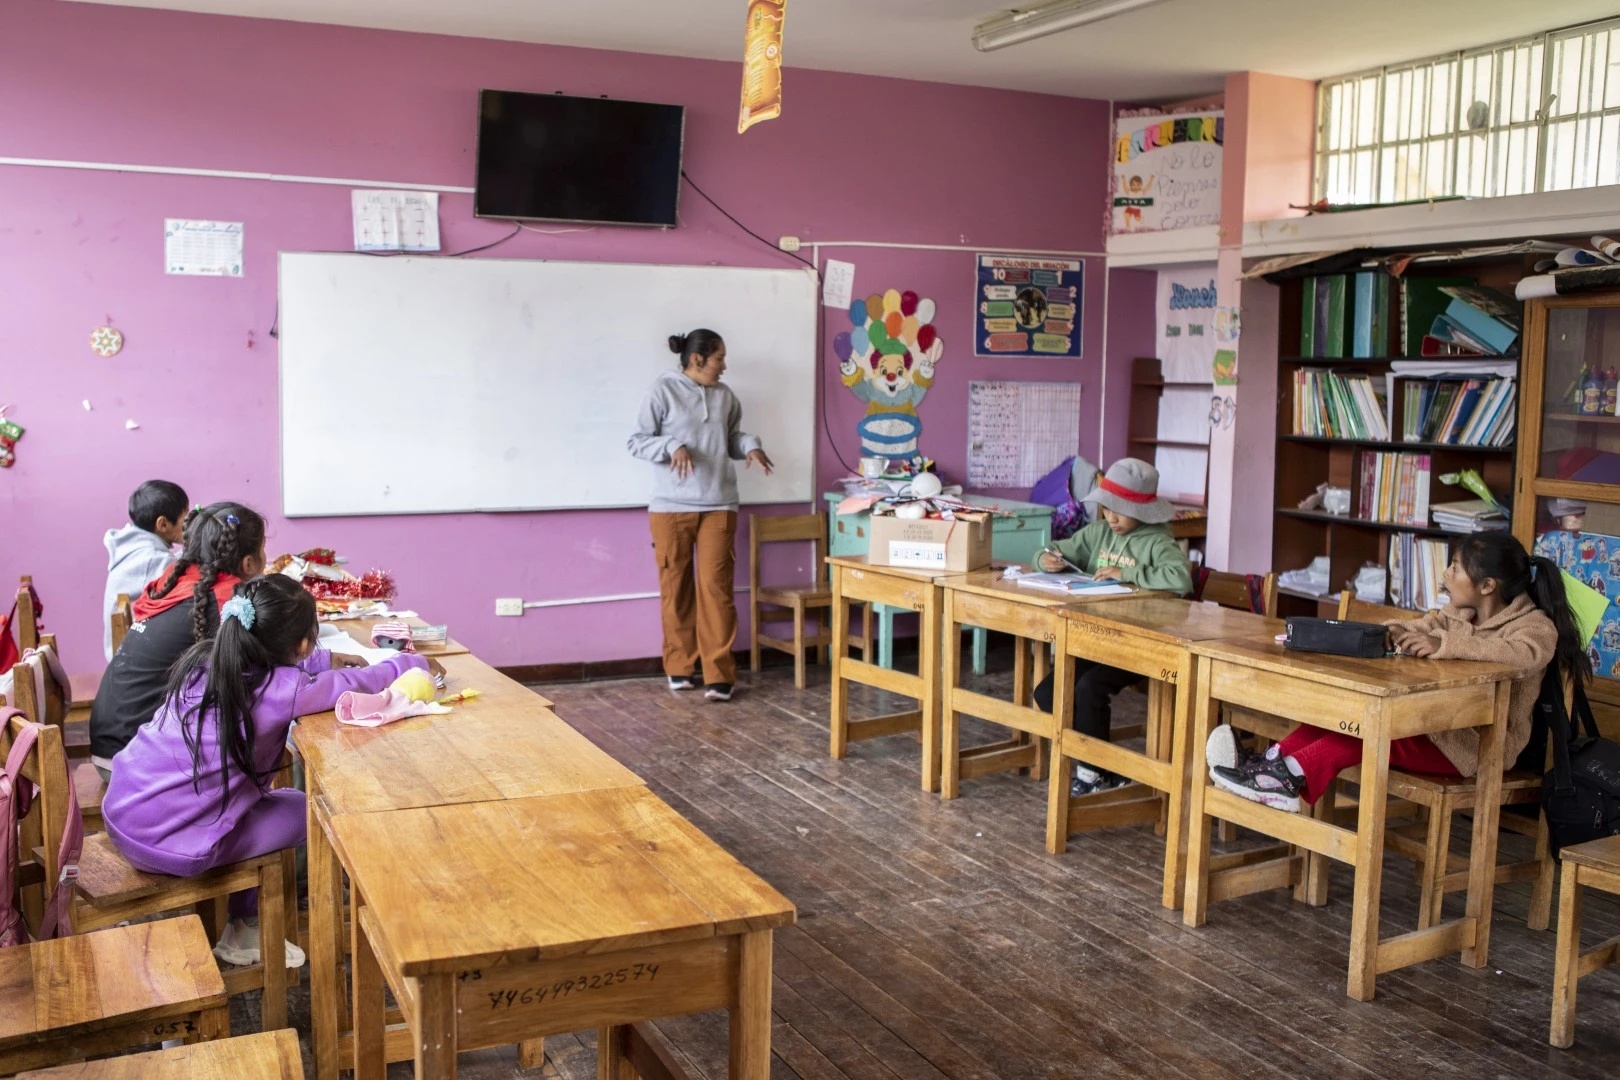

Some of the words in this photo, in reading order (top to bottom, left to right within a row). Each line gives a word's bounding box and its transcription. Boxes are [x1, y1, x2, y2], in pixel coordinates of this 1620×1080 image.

[992, 268, 1006, 280] 10
[1160, 668, 1178, 684] 064
[1339, 720, 1360, 736] 061
